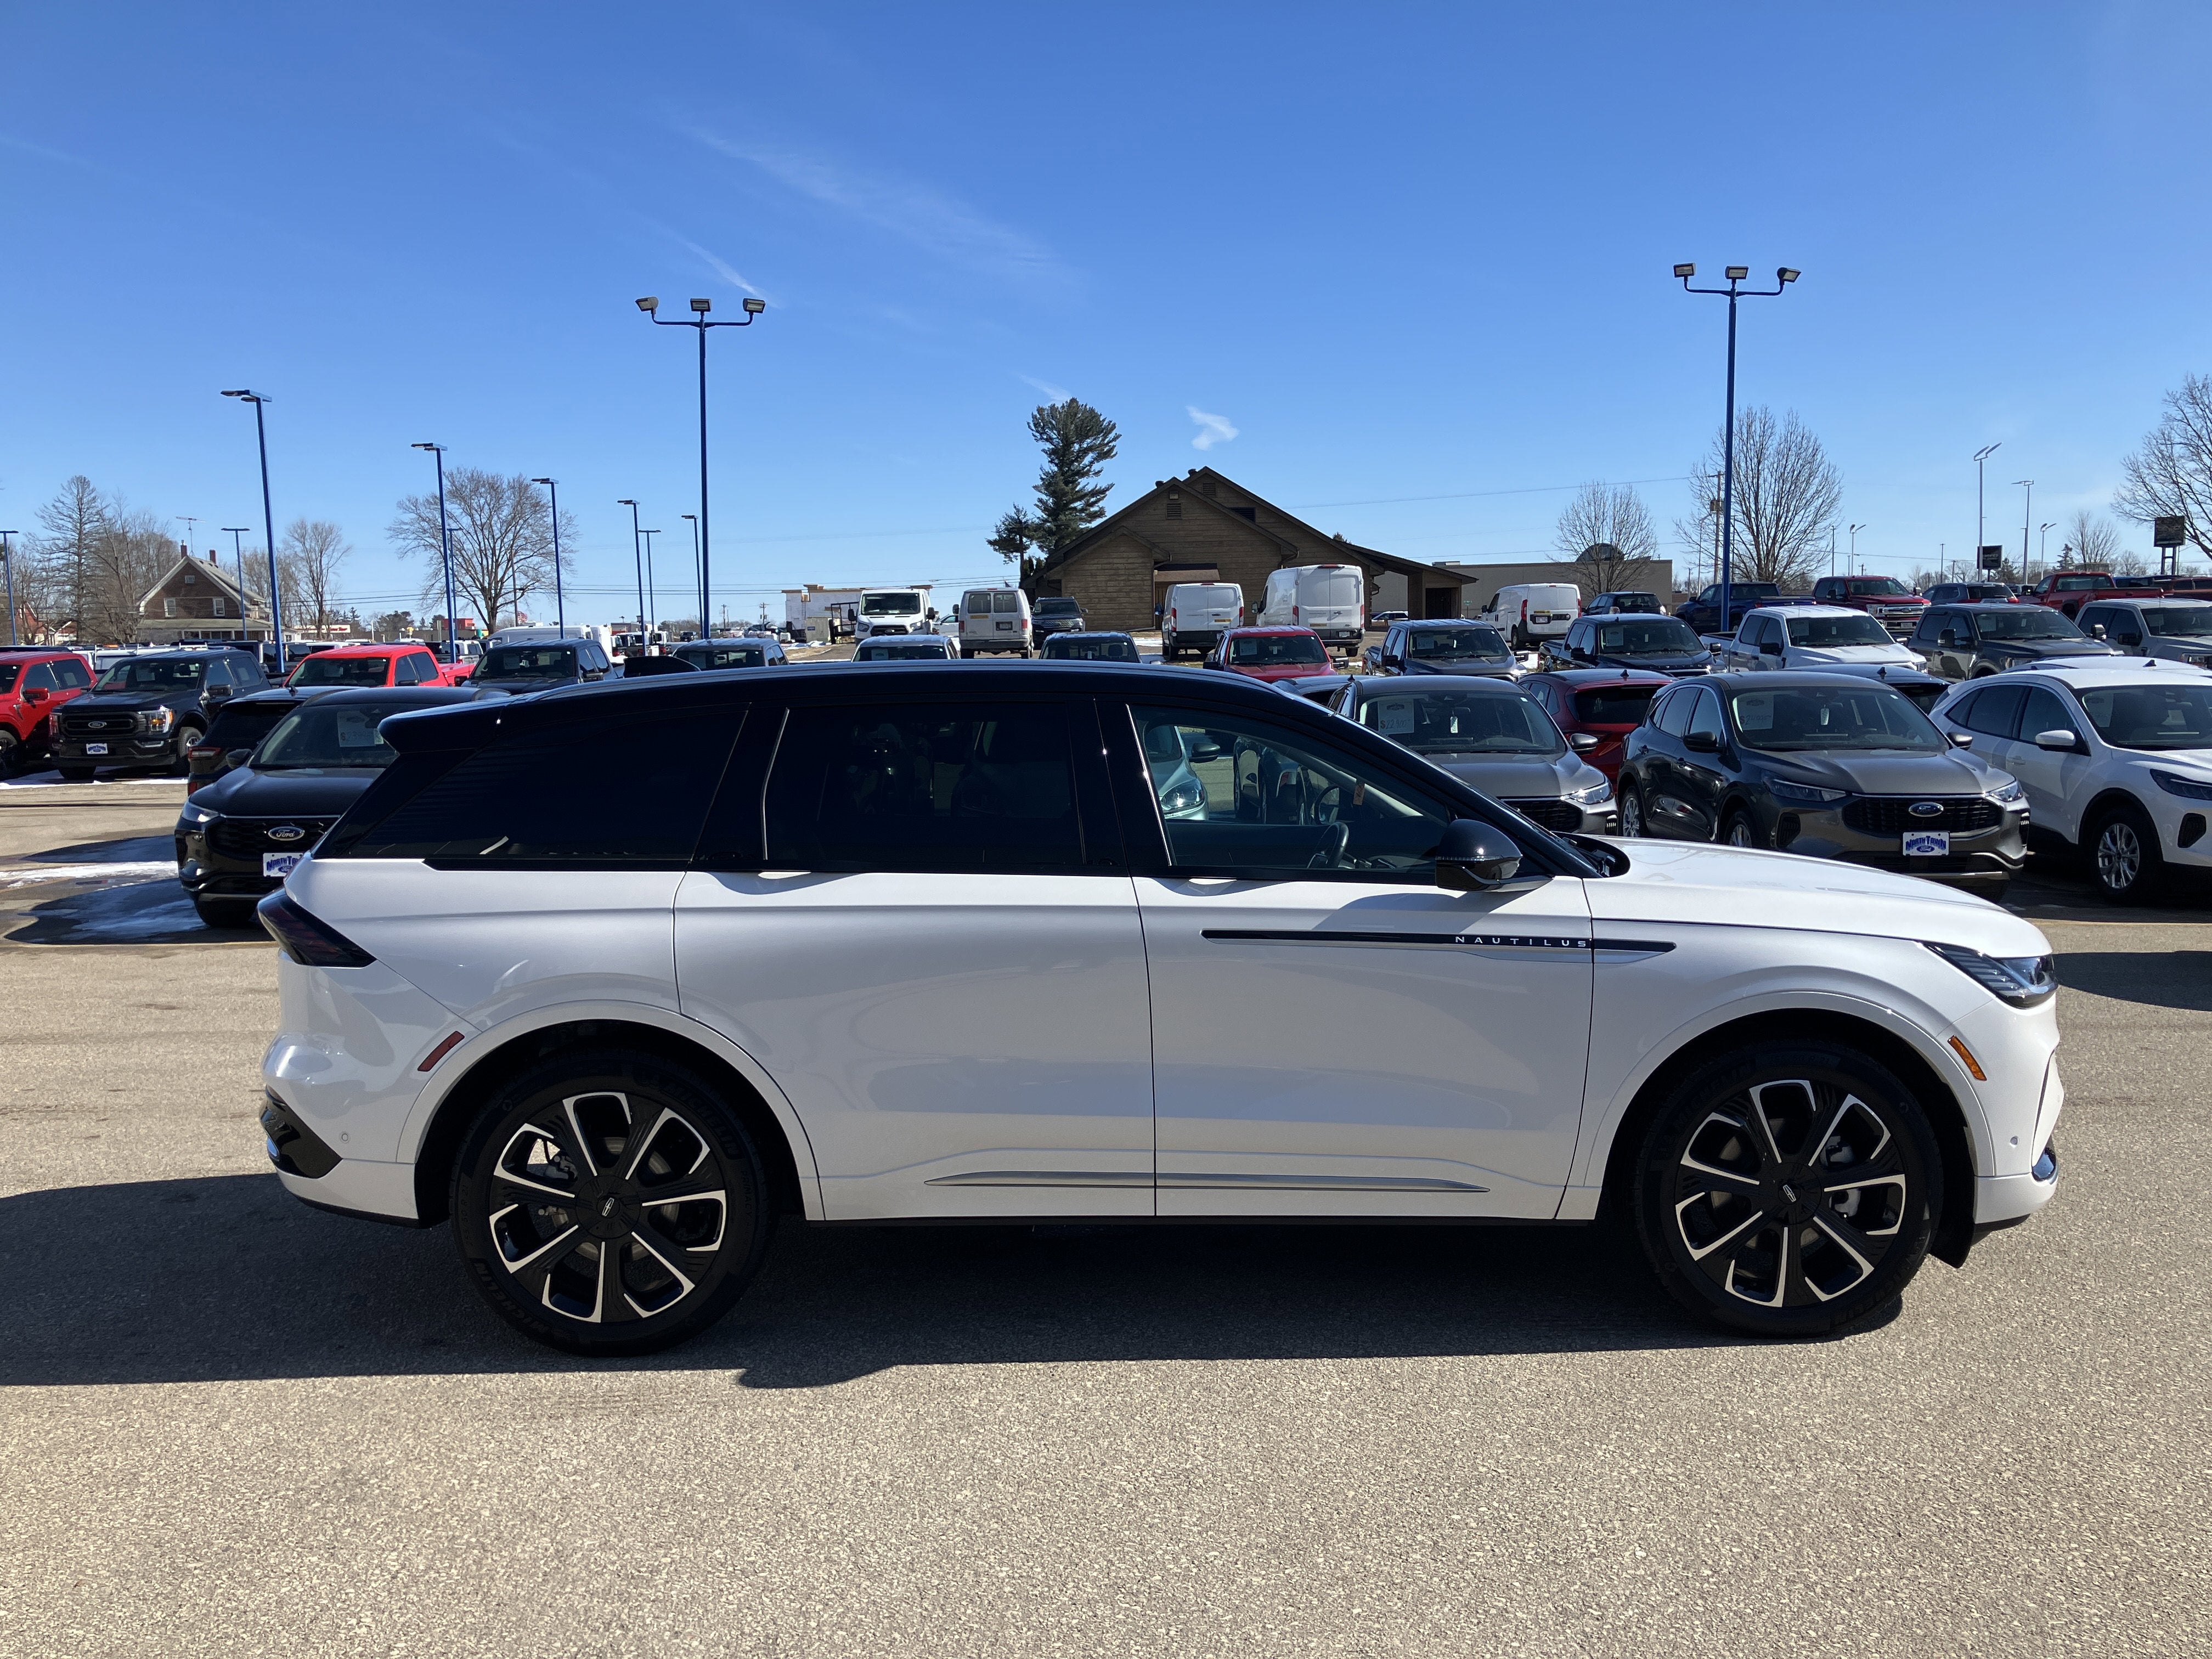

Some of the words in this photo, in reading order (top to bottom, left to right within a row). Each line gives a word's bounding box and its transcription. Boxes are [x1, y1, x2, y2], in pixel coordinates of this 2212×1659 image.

[276, 829, 296, 838] Ford
[1455, 936, 1587, 947] NAUTILUS
[473, 1262, 550, 1334] MICHELIN
